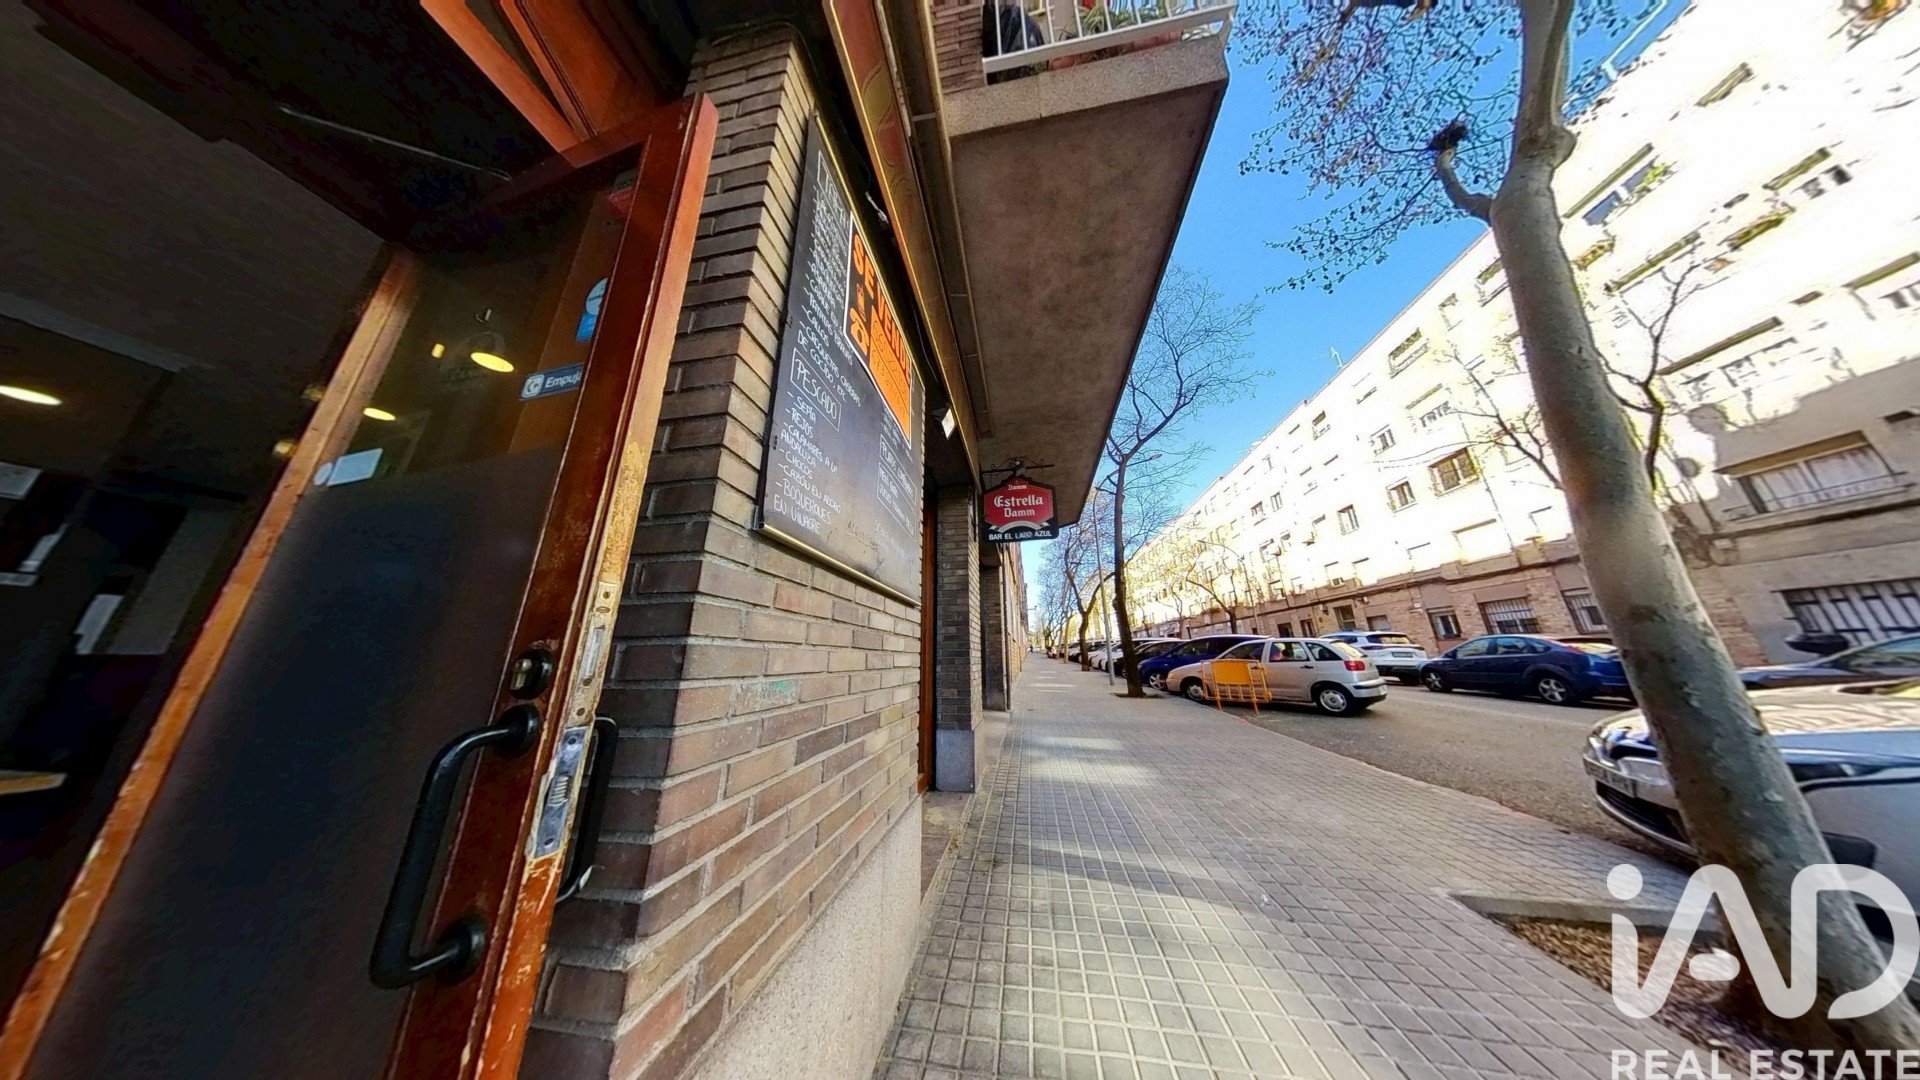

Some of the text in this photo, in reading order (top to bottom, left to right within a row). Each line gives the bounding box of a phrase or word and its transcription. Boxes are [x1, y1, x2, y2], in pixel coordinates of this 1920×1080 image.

[853, 233, 874, 300] SE
[877, 281, 911, 386] VENDE
[797, 328, 808, 354] DE
[793, 353, 837, 425] PESCADO
[791, 406, 813, 440] REJOS
[780, 427, 816, 469] ANDALUZA
[788, 420, 837, 475] CALAMARES A LA
[785, 448, 813, 481] CHOCOS
[773, 493, 787, 516] EN
[811, 484, 821, 500] EN
[993, 494, 1044, 508] Estrella
[1004, 508, 1036, 518] Damm
